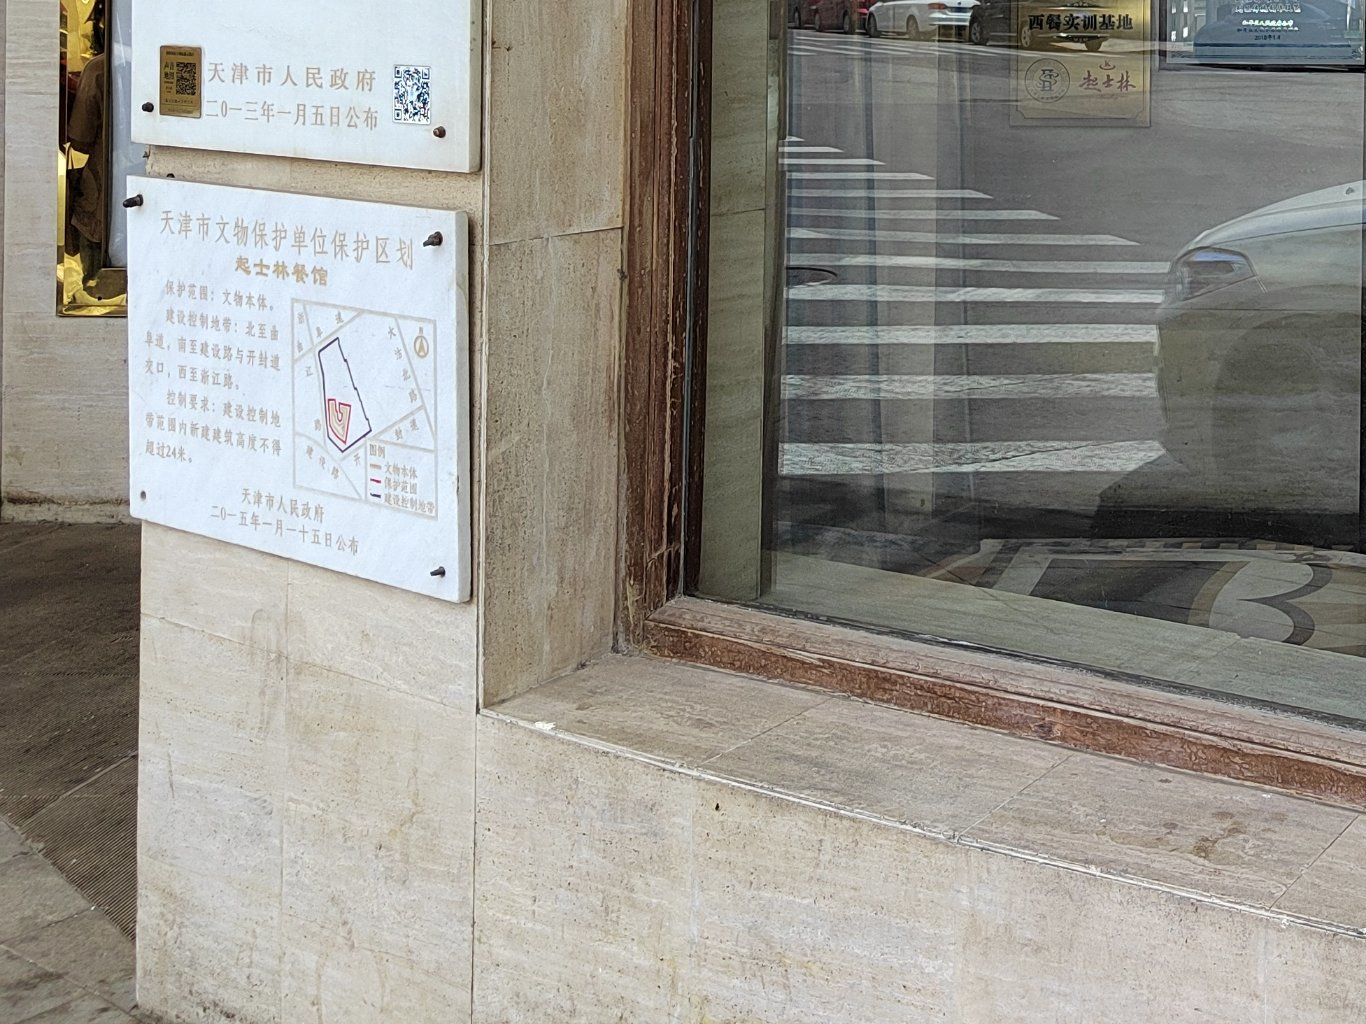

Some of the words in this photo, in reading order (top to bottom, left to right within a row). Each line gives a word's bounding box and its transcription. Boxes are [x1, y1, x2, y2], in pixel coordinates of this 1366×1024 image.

[1028, 14, 1133, 30] 西餐实训基地
[208, 63, 376, 92] 天津市人民政府
[1079, 71, 1136, 92] 起士林
[160, 210, 414, 270] 天津市文物保护单位保护区划
[235, 256, 329, 287] 起士林餐馆
[241, 488, 324, 521] 天津市人民政府
